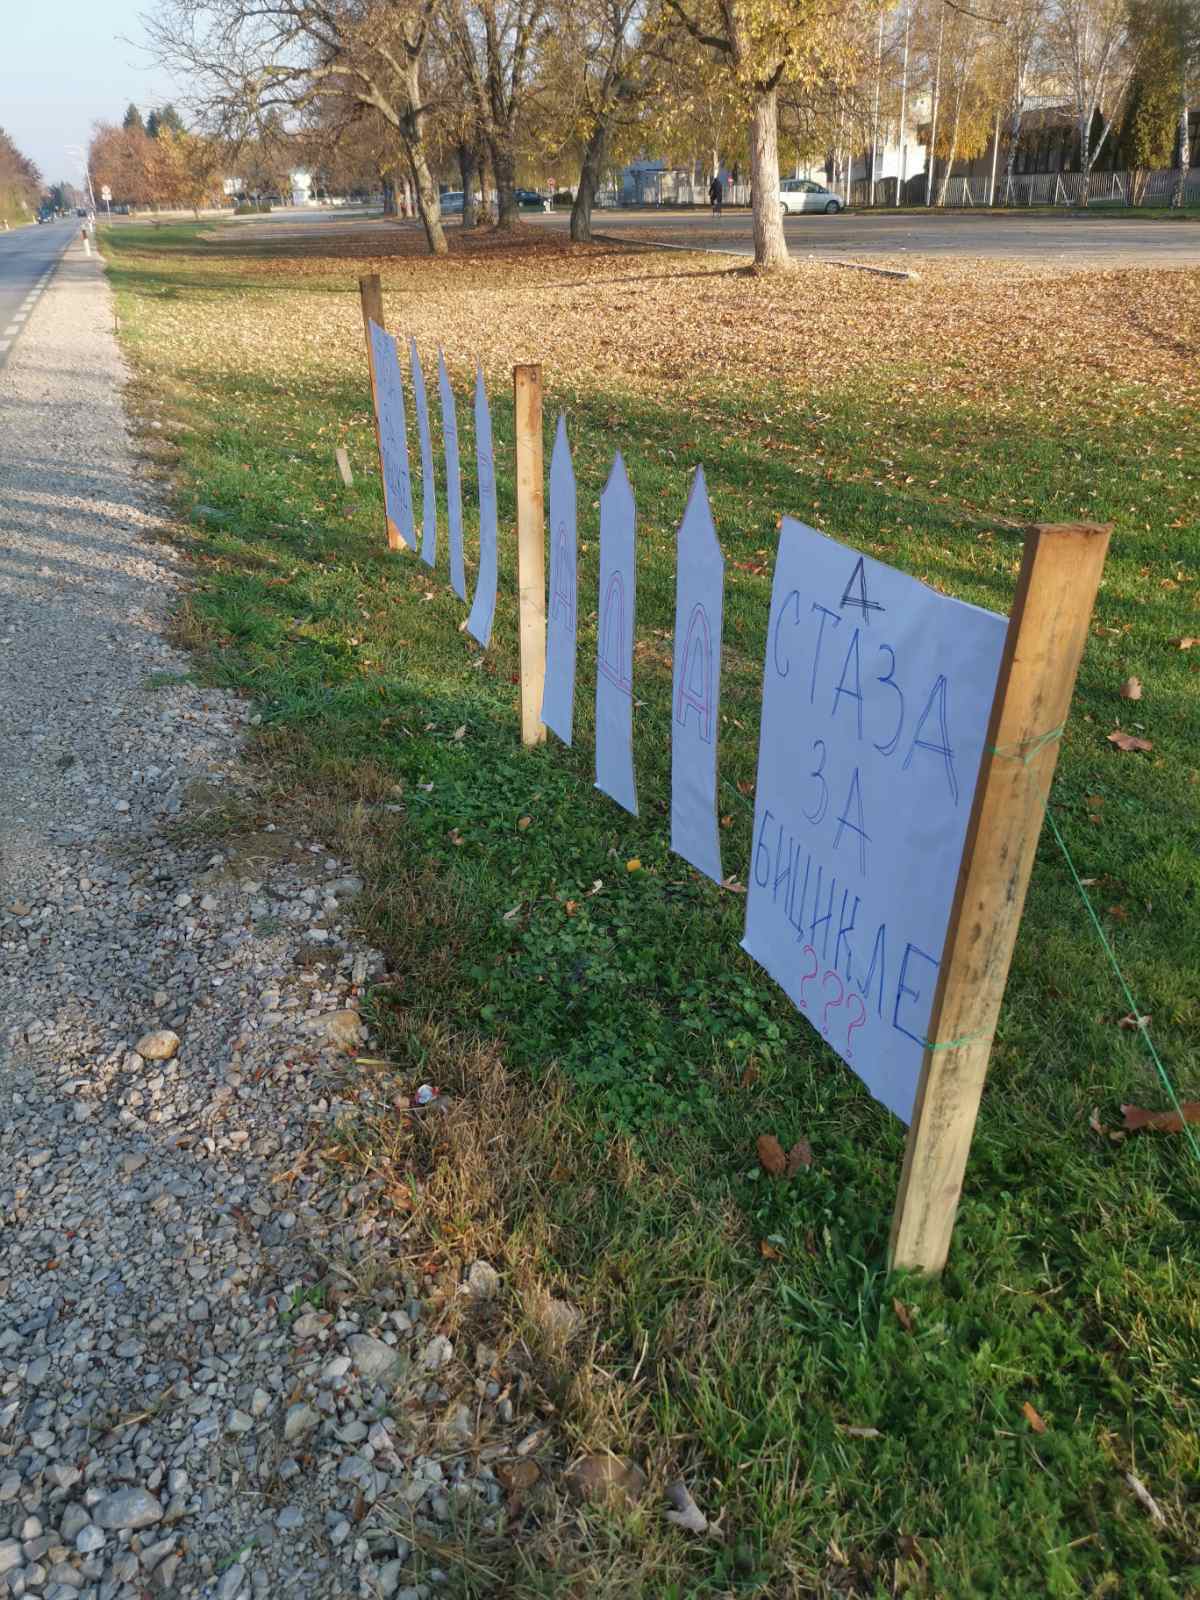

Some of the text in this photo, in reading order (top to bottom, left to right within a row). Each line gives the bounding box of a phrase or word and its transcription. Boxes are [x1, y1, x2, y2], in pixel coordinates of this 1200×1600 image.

[839, 555, 886, 626] А
[773, 588, 959, 807] СТАЗА
[801, 739, 873, 878] ЗА
[799, 944, 867, 1060] ???
